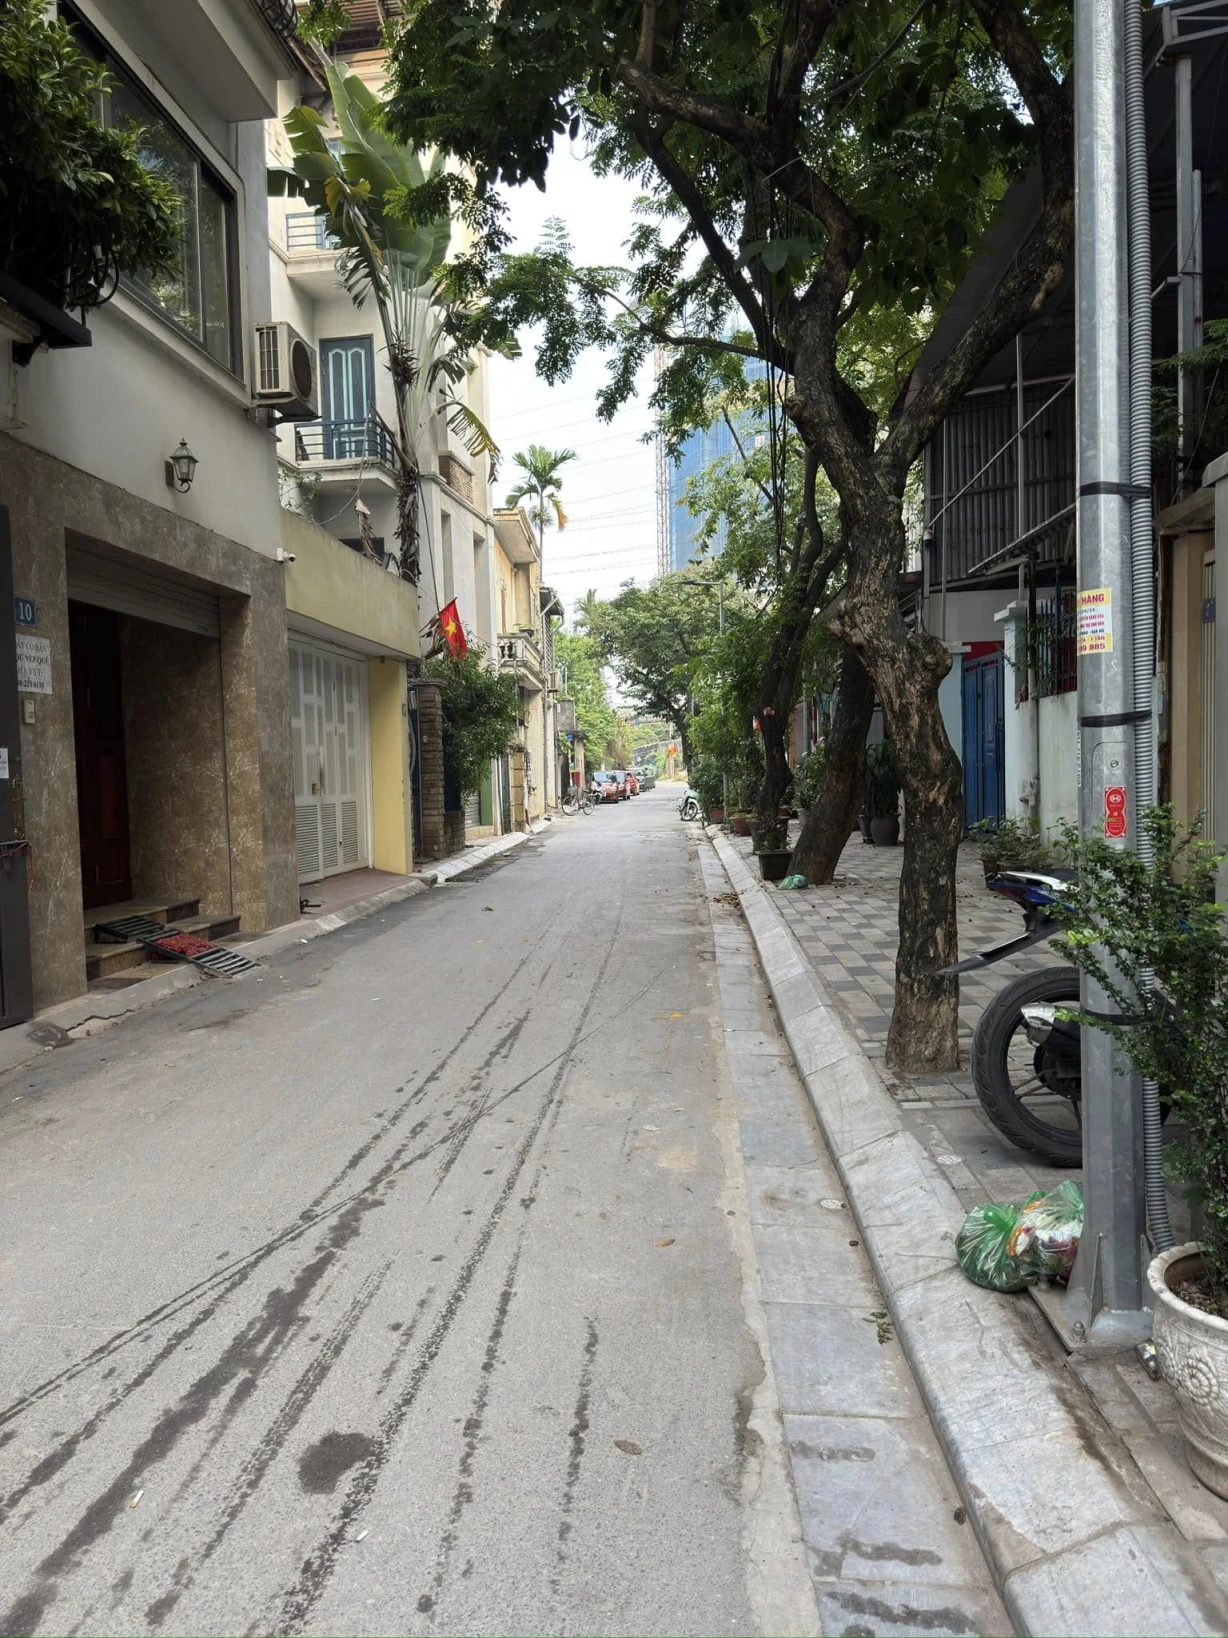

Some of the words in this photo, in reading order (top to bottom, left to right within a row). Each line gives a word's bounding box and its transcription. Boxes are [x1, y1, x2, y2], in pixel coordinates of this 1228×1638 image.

[1081, 593, 1105, 605] HÀNG
[19, 602, 32, 621] 10
[1089, 642, 1106, 651] 885
